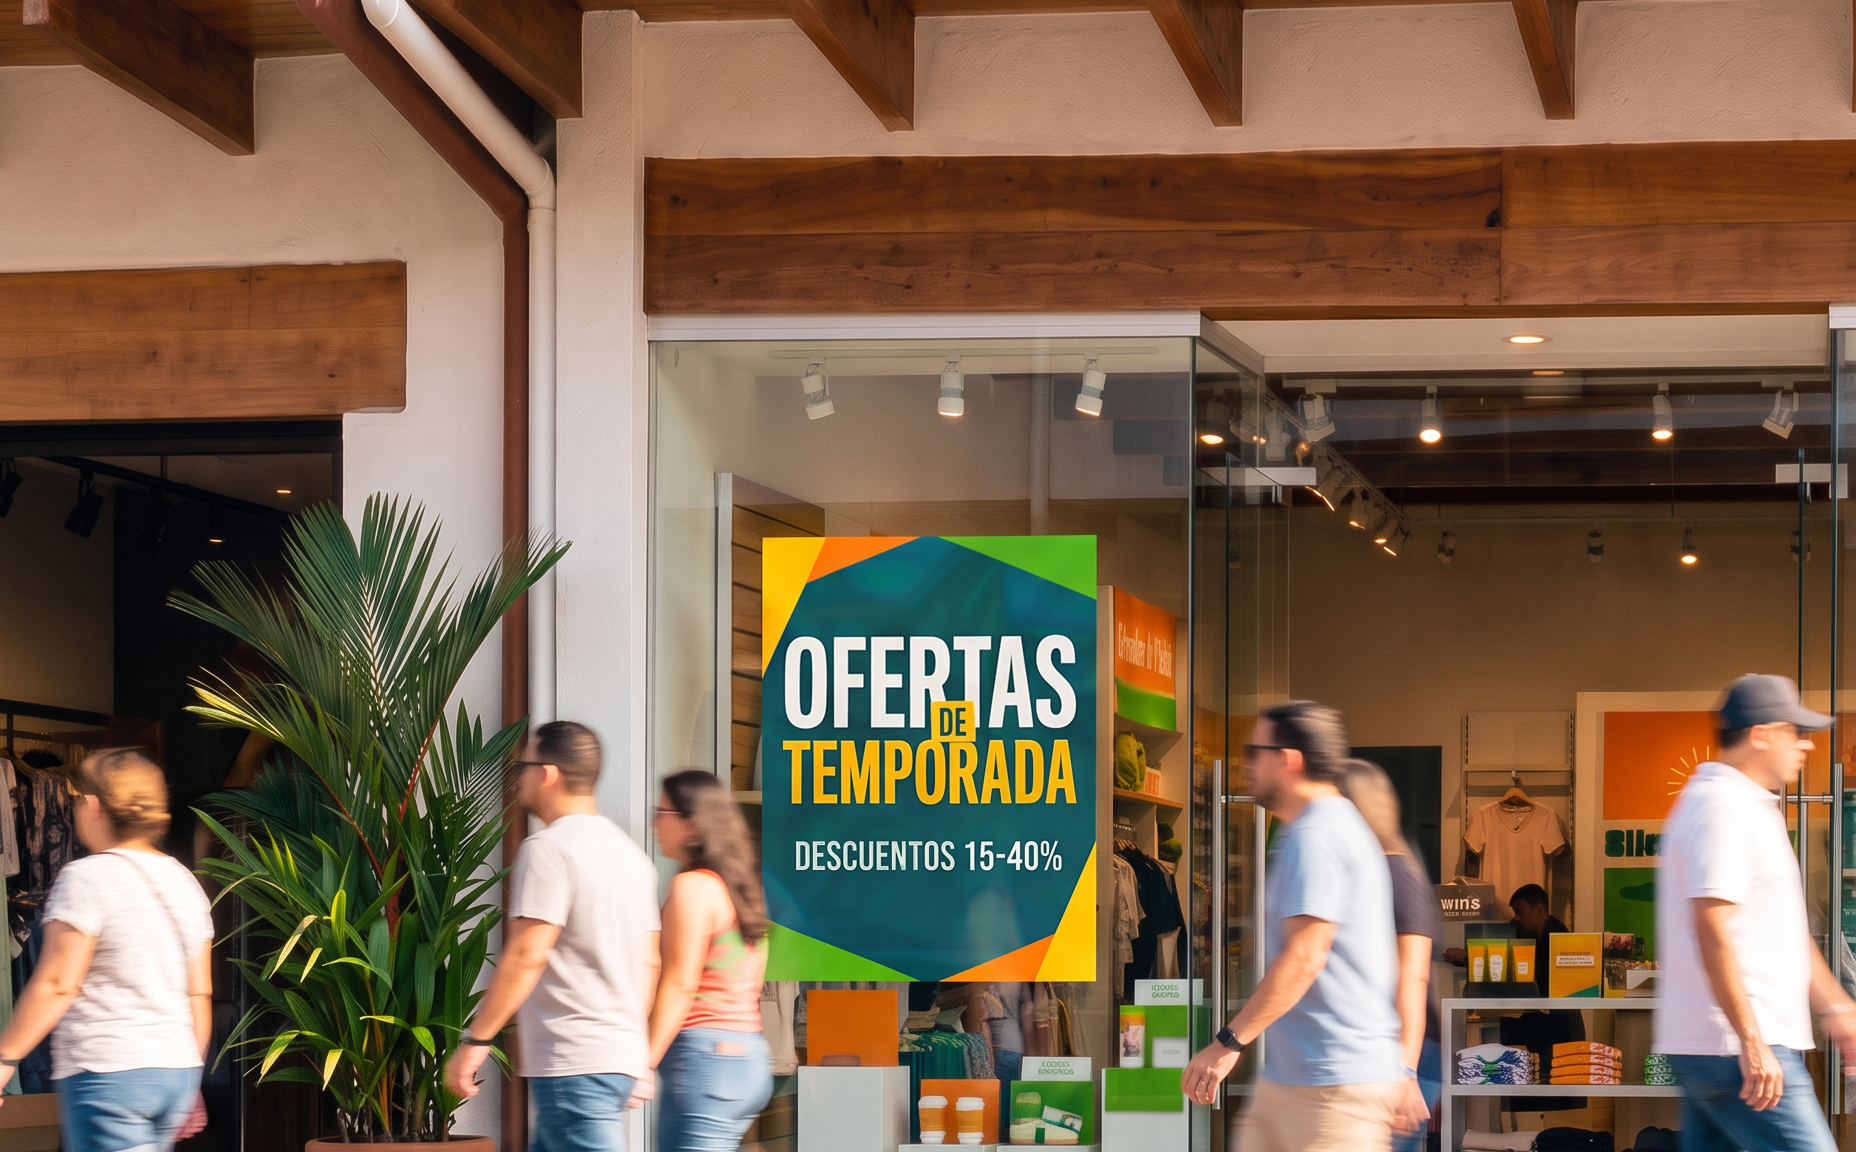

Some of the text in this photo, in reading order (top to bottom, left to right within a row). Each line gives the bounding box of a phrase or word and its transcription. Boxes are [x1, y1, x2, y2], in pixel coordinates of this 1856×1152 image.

[784, 634, 1077, 729] OFERTAS
[939, 707, 967, 737] DE
[782, 739, 1077, 806] TEMPORADA
[795, 840, 1063, 871] DESCUENTOS 15-40%
